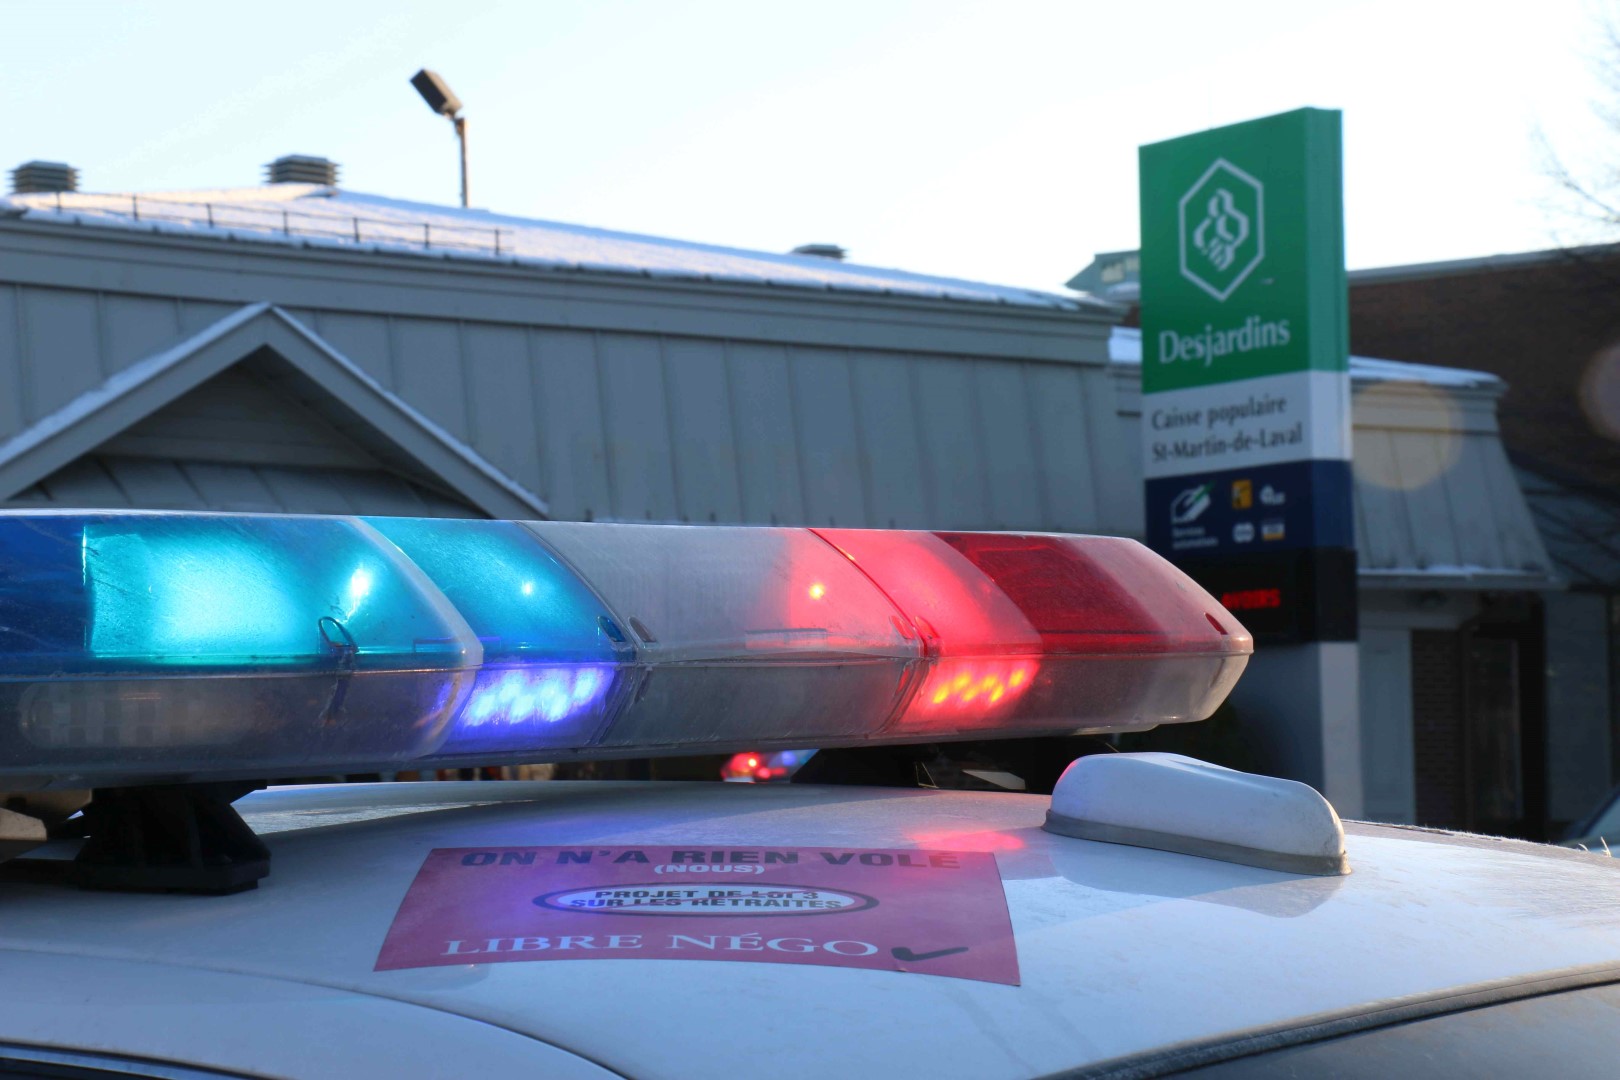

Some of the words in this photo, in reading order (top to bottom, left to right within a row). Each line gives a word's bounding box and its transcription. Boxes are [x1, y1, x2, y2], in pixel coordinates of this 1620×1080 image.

[1159, 315, 1290, 366] Desjardins
[1151, 408, 1202, 430] Caisse
[1207, 395, 1286, 428] populaire
[1152, 422, 1302, 461] St-Martin-de-Laval
[463, 851, 536, 866] ON
[672, 850, 799, 864] RIEN
[821, 851, 959, 868] VOLÉ
[654, 864, 764, 874] (NOUS)
[570, 898, 625, 907] SUR
[634, 898, 681, 907] LES
[692, 898, 842, 909] RETRAITES
[596, 889, 698, 898] PROJET
[708, 889, 746, 898] DE
[802, 891, 817, 899] 3
[442, 934, 644, 956] LIBRE
[668, 932, 880, 955] NÉGO
